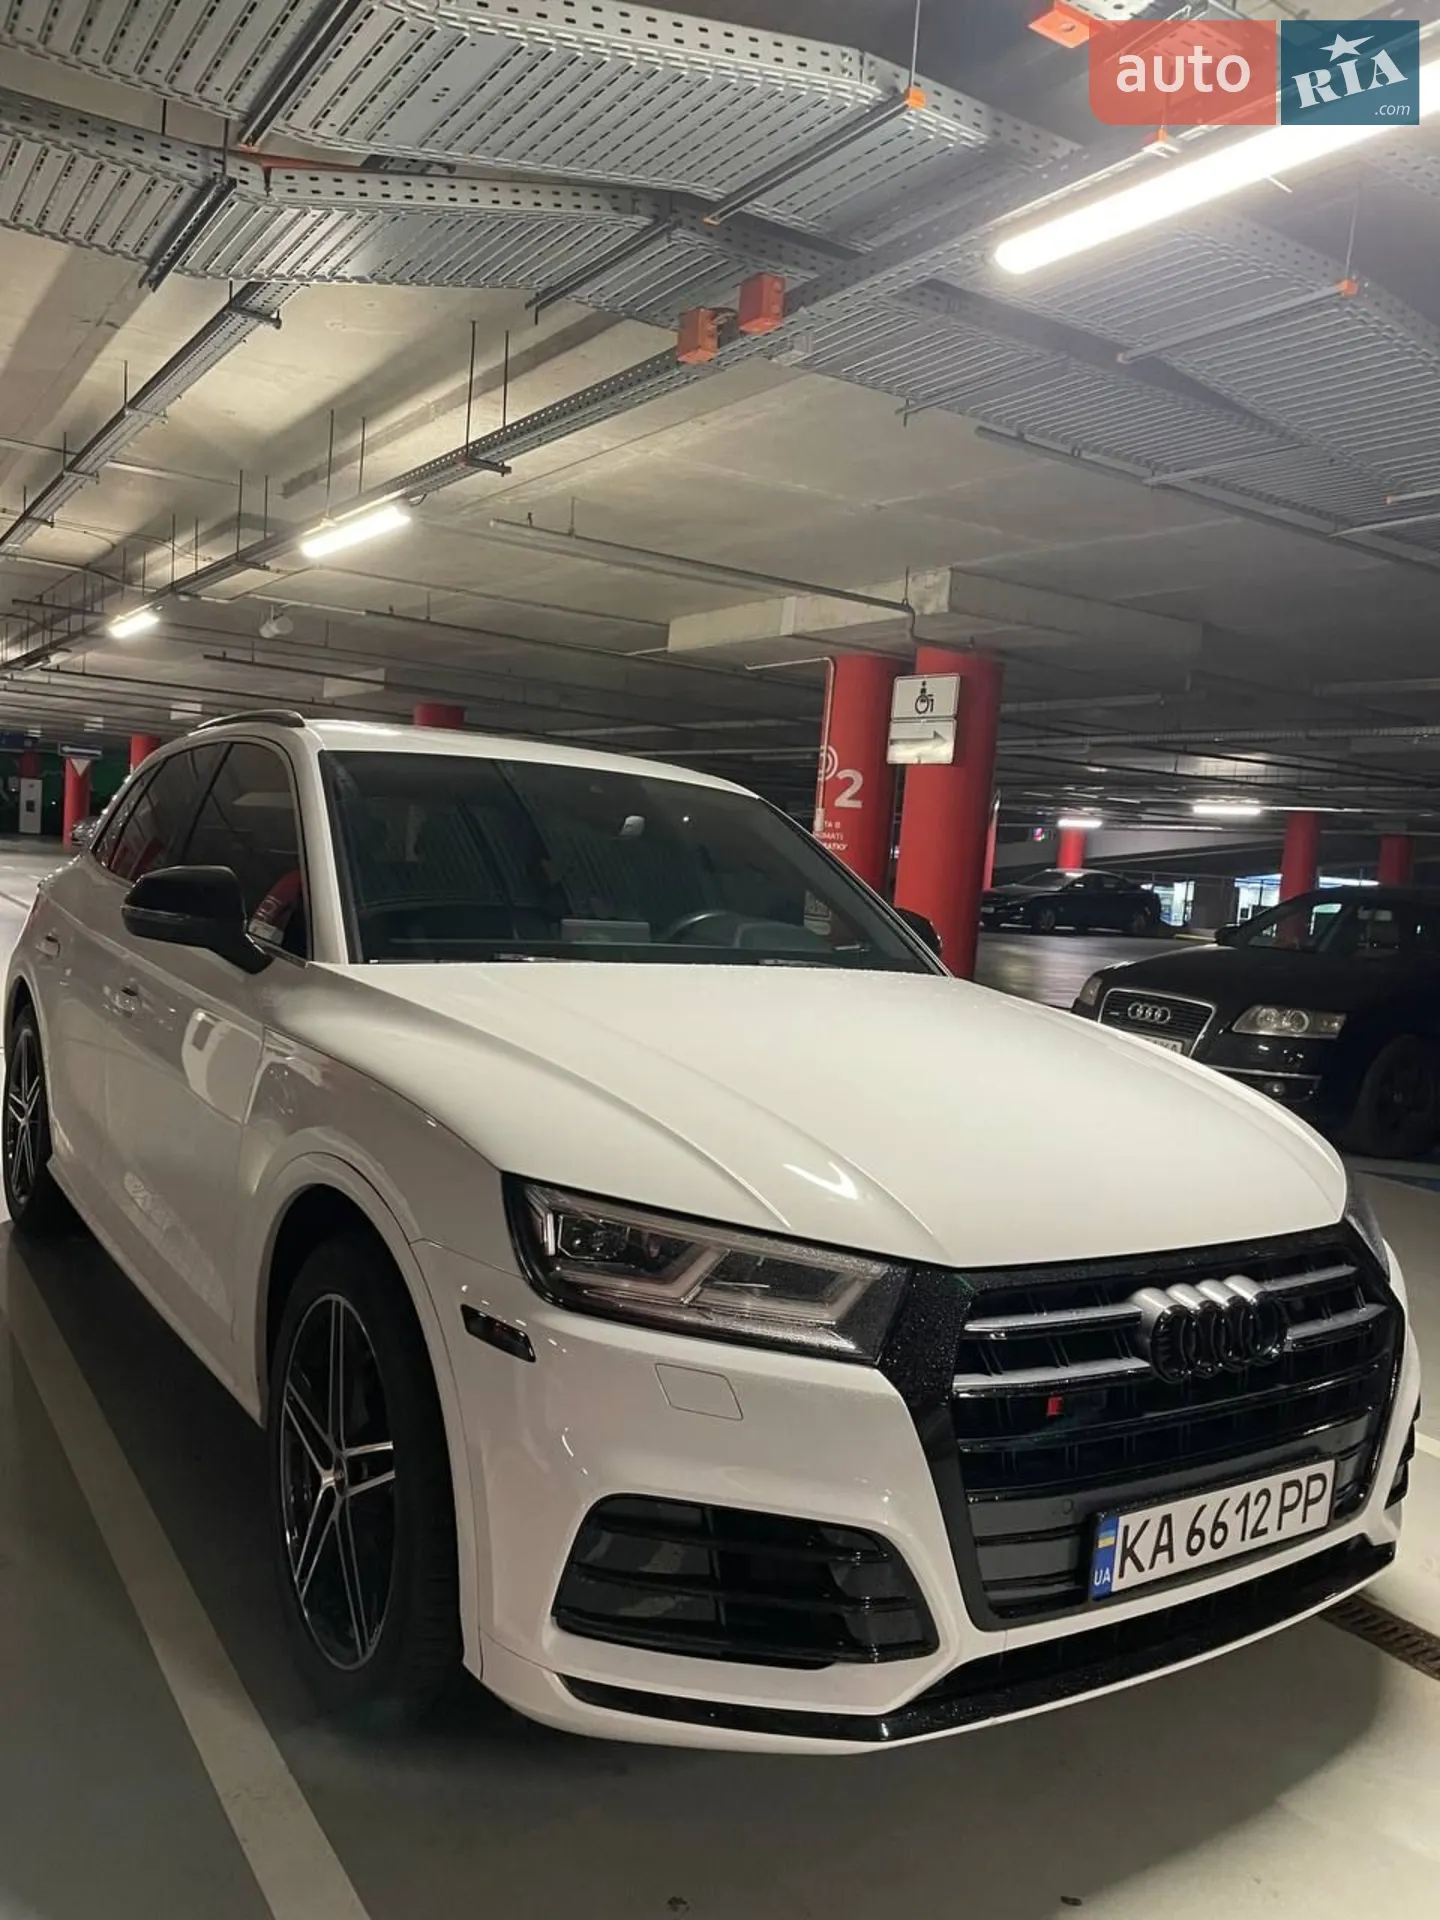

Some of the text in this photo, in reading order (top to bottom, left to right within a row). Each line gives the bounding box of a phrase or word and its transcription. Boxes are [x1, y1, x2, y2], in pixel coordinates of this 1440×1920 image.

[834, 768, 864, 809] 2
[1118, 1472, 1328, 1579] KA 6612 PP
[1094, 1568, 1111, 1586] UA
